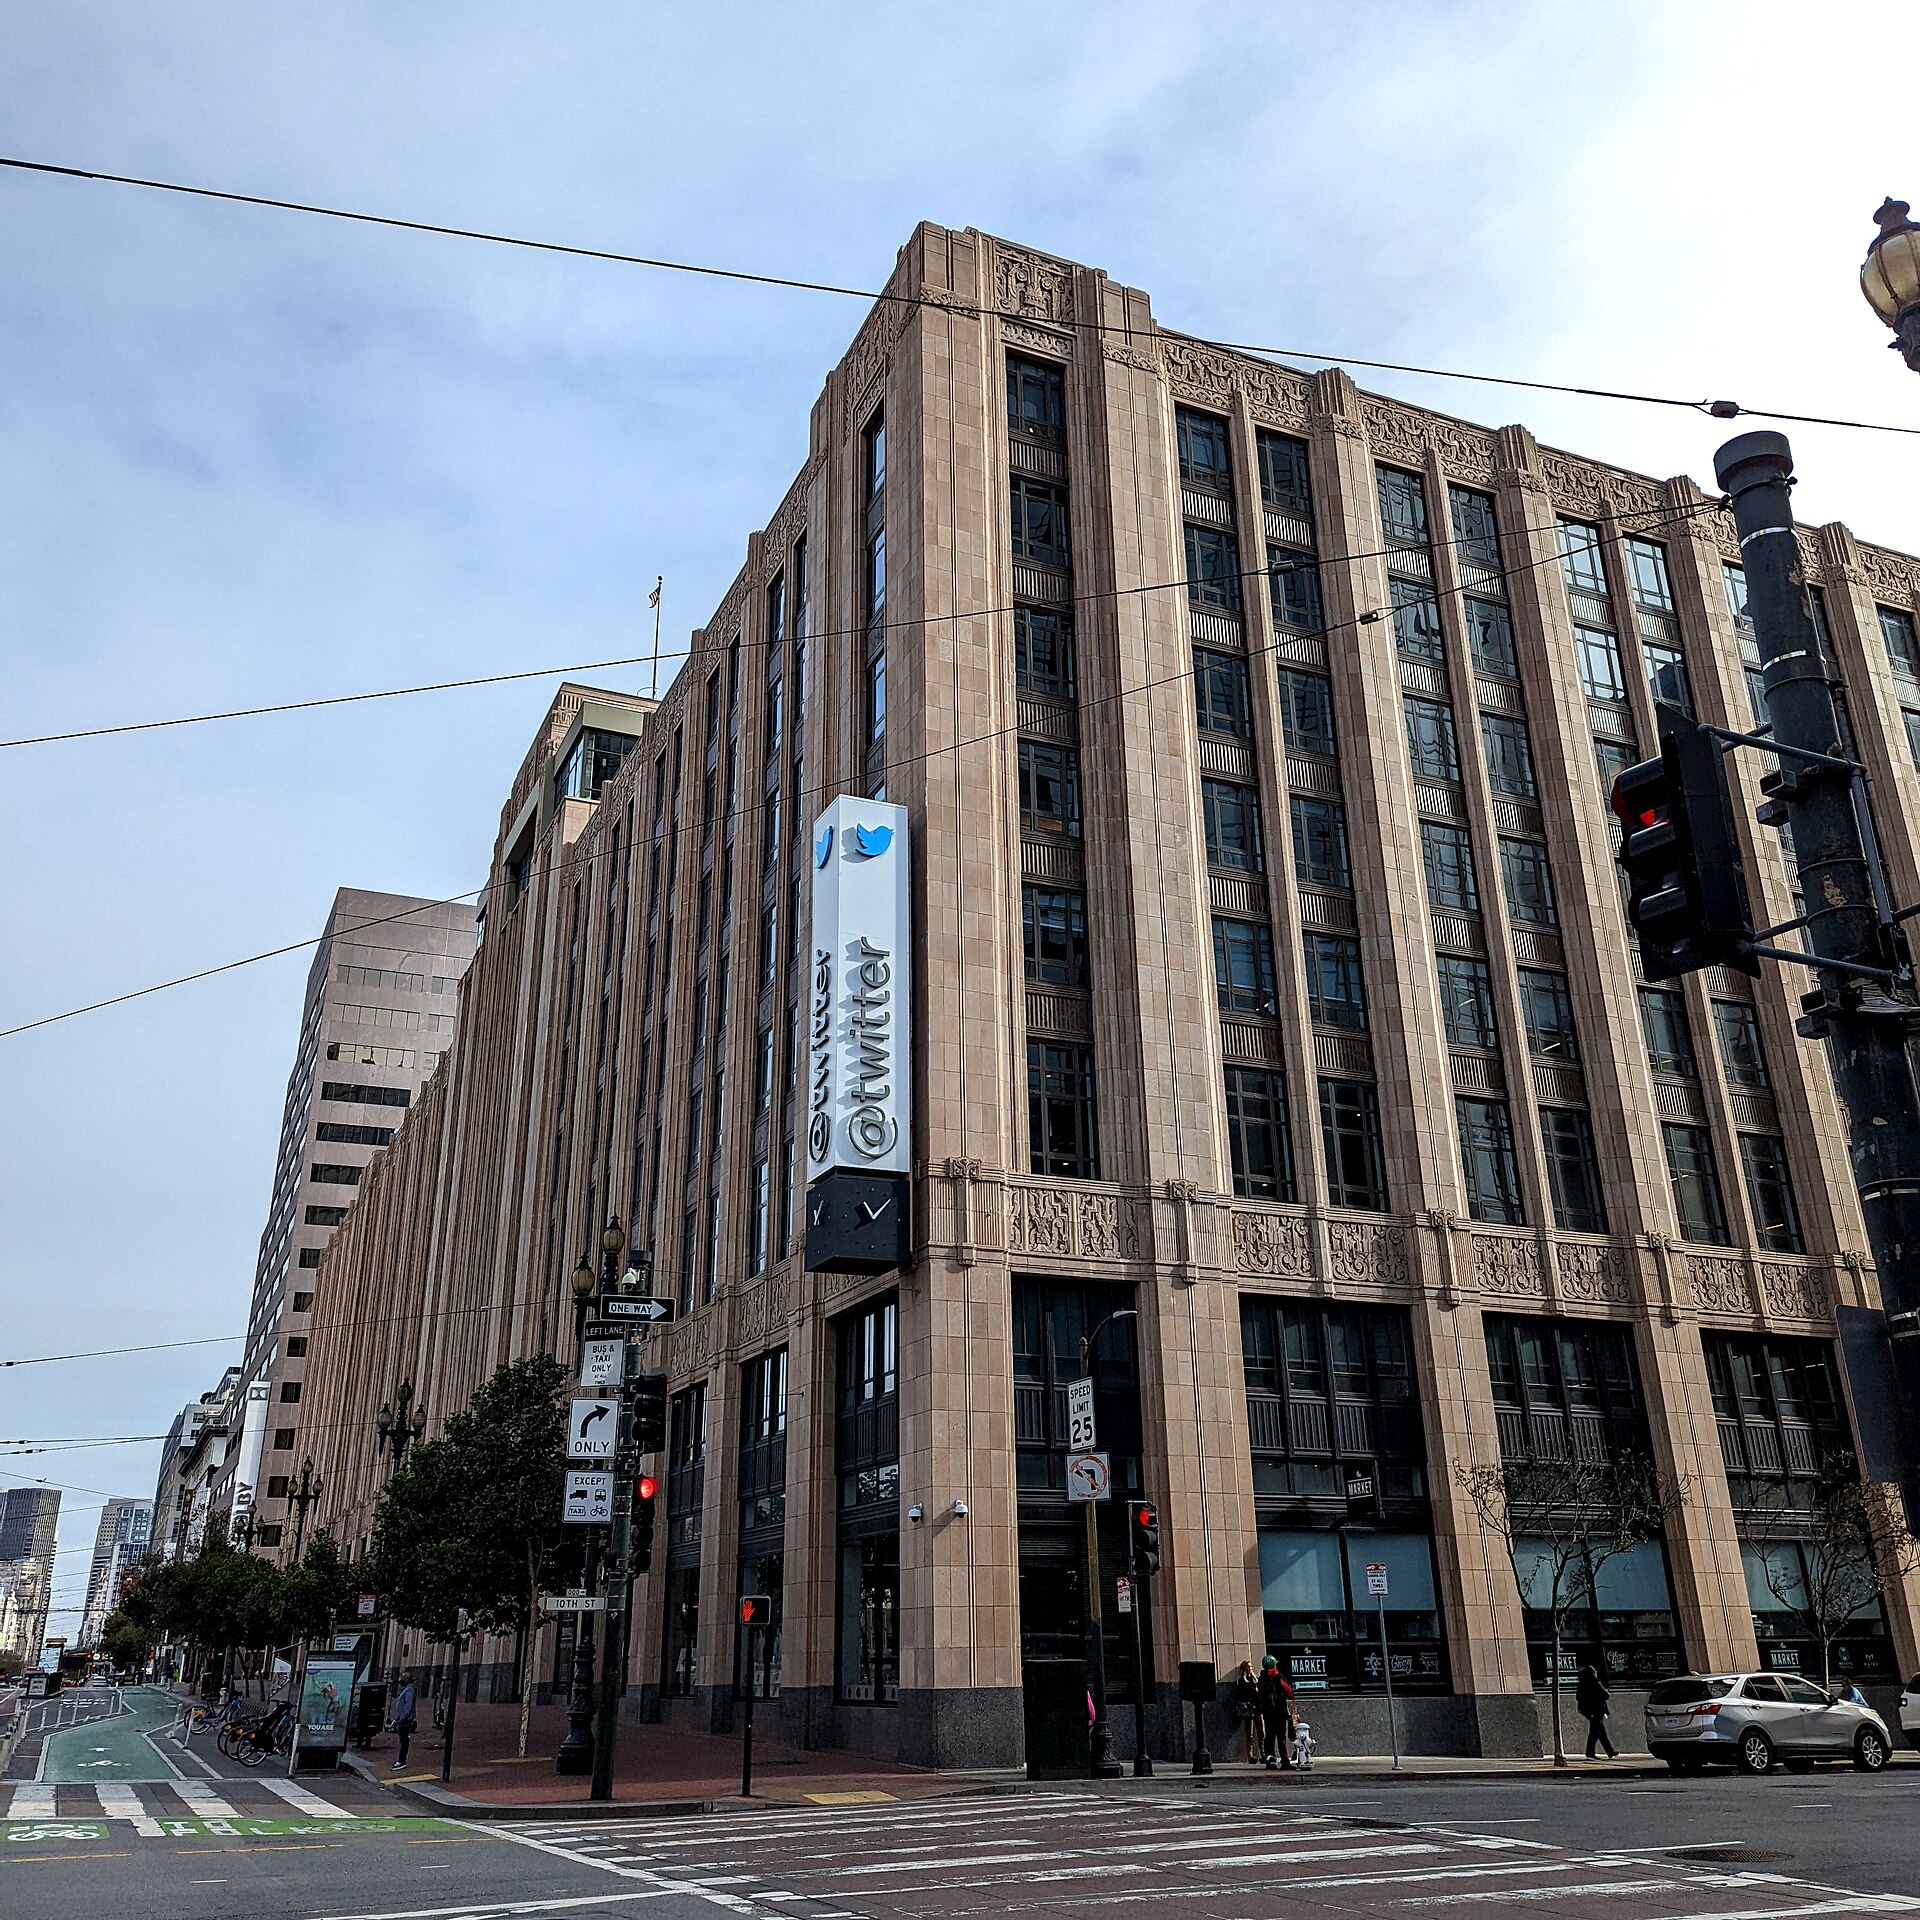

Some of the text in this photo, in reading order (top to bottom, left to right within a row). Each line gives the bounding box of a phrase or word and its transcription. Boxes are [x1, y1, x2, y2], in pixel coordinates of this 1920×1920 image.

[848, 936, 898, 1158] @twitter
[610, 1303, 653, 1314] ONE WAY
[585, 1325, 624, 1336] LEFT LANE
[592, 1344, 615, 1353] BUS &
[594, 1354, 611, 1362] TAXI
[591, 1364, 612, 1373] ONLY
[1070, 1384, 1091, 1400] SPEED
[1072, 1400, 1090, 1414] LIMIT
[1071, 1415, 1093, 1444] 25
[574, 1441, 610, 1453] ONLY
[574, 1476, 607, 1486] EXCEPT
[1348, 1480, 1372, 1495] MARKET
[556, 1599, 596, 1608] 10TH ST
[1545, 1656, 1577, 1669] MRKET
[1770, 1653, 1799, 1665] MARKET
[1291, 1659, 1326, 1673] MARKET
